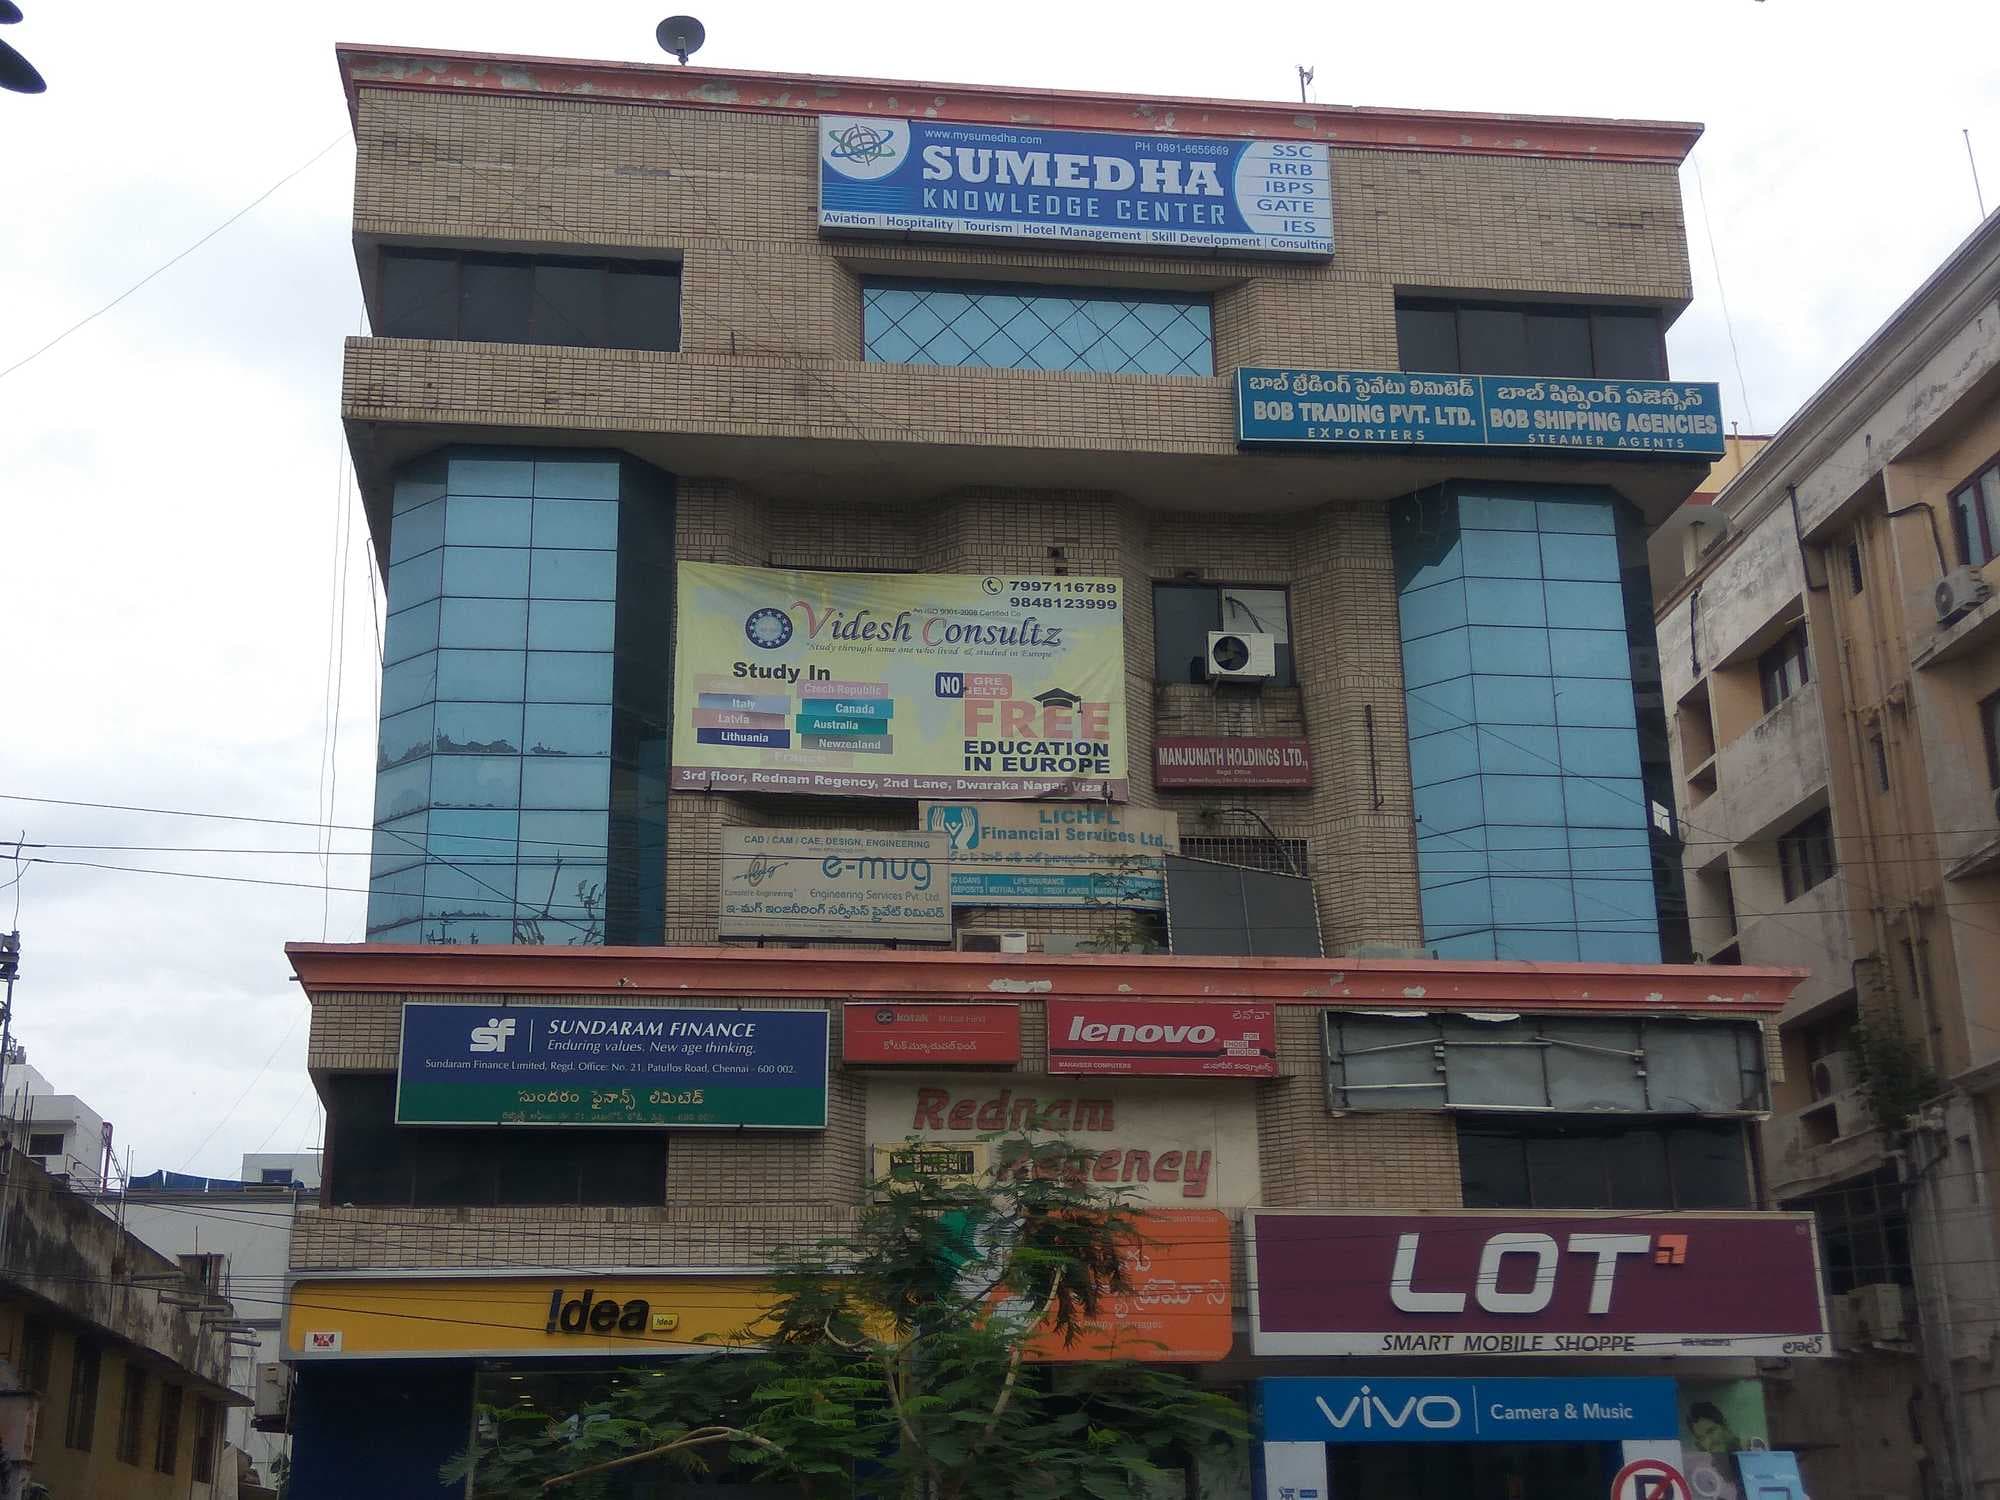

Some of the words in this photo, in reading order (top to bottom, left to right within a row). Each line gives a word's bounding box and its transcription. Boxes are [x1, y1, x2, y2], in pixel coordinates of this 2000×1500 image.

[924, 128, 1042, 145] www.mysumedha.com
[1272, 144, 1313, 157] SSC
[922, 145, 1225, 197] SUMEDHA
[1269, 162, 1313, 176] RRB
[1266, 180, 1314, 194] IBPS
[923, 187, 1099, 218] KNOWLEDGE
[1116, 199, 1225, 225] CENTER
[1257, 198, 1314, 213] GATE
[823, 212, 876, 226] Aviation
[886, 215, 954, 232] Hospitality
[963, 220, 1013, 234] Tourism
[1023, 224, 1057, 236] Hotel
[1060, 226, 1142, 242] Management
[1151, 231, 1176, 243] Skill
[1180, 232, 1261, 250] Development
[1270, 236, 1334, 253] Consulting
[1283, 220, 1316, 234] IES
[1253, 400, 1295, 421] BOB
[1299, 402, 1386, 424] TRADING
[1389, 404, 1431, 424] PVT.
[1434, 406, 1477, 426] LTD.
[1489, 408, 1530, 428] BOB
[1533, 409, 1622, 432] SHIPPING
[1626, 412, 1718, 434] AGENCIES
[1308, 427, 1425, 440] EXPORTERS
[1528, 433, 1604, 446] STEAMER
[1618, 436, 1685, 448] AGENTS
[1009, 581, 1117, 594] 7997116789
[1010, 597, 1118, 610] 9848123999
[790, 600, 912, 643] Videsh
[922, 616, 1064, 648] Consultz
[732, 661, 801, 684] Study
[809, 664, 831, 681] In
[939, 675, 960, 694] NO
[973, 677, 1001, 686] GRE
[804, 684, 834, 695] Czech
[836, 685, 881, 697] Republic
[732, 698, 756, 711] Italy
[835, 703, 875, 715] Canada
[718, 713, 751, 724] Latvia
[813, 719, 859, 731] Australia
[964, 699, 1110, 741] FREE
[721, 731, 769, 743] Lithuania
[818, 738, 881, 750] Newzealand
[964, 740, 1109, 757] EDUCATION
[1159, 747, 1223, 766] MANJUNATH
[1227, 748, 1280, 766] HOLDINGS
[964, 756, 992, 772] IN
[1002, 756, 1111, 774] EUROPE
[682, 771, 706, 781] 3rd
[710, 771, 748, 784] floor,
[752, 773, 810, 785] Rednam
[814, 777, 879, 789] Regency,
[883, 778, 911, 788] 2nd
[913, 778, 952, 790] Lane,
[956, 780, 1019, 791] Dwaraka
[1072, 782, 1111, 795] Viza
[772, 836, 793, 845] CAM
[866, 839, 930, 849] ENGINEERING
[981, 826, 1060, 842] Financial
[1065, 828, 1136, 844] Services
[822, 854, 932, 891] e-mug
[809, 888, 864, 901] Engineering
[865, 890, 903, 900] Services
[548, 1018, 663, 1037] SUNDARAM
[669, 1022, 756, 1038] FINANCE
[1068, 1016, 1216, 1045] lenovo
[547, 1039, 601, 1055] Enduring
[605, 1040, 645, 1053] values.
[649, 1041, 678, 1053] New
[681, 1044, 702, 1056] age
[705, 1041, 756, 1057] thinking.
[425, 1059, 471, 1069] Sundaram
[473, 1060, 509, 1070] Finance
[647, 1063, 682, 1073] Patullos
[712, 1063, 749, 1073] Chennai
[757, 1064, 775, 1073] 600
[1390, 1232, 1651, 1315] LOT
[1382, 1334, 1455, 1351] SMART
[1464, 1335, 1544, 1351] MOBILE
[1555, 1335, 1635, 1352] SHOPPE
[1315, 1385, 1462, 1429] vivo
[1490, 1403, 1560, 1420] Camera
[1564, 1403, 1578, 1419] &
[1583, 1402, 1633, 1419] Music
